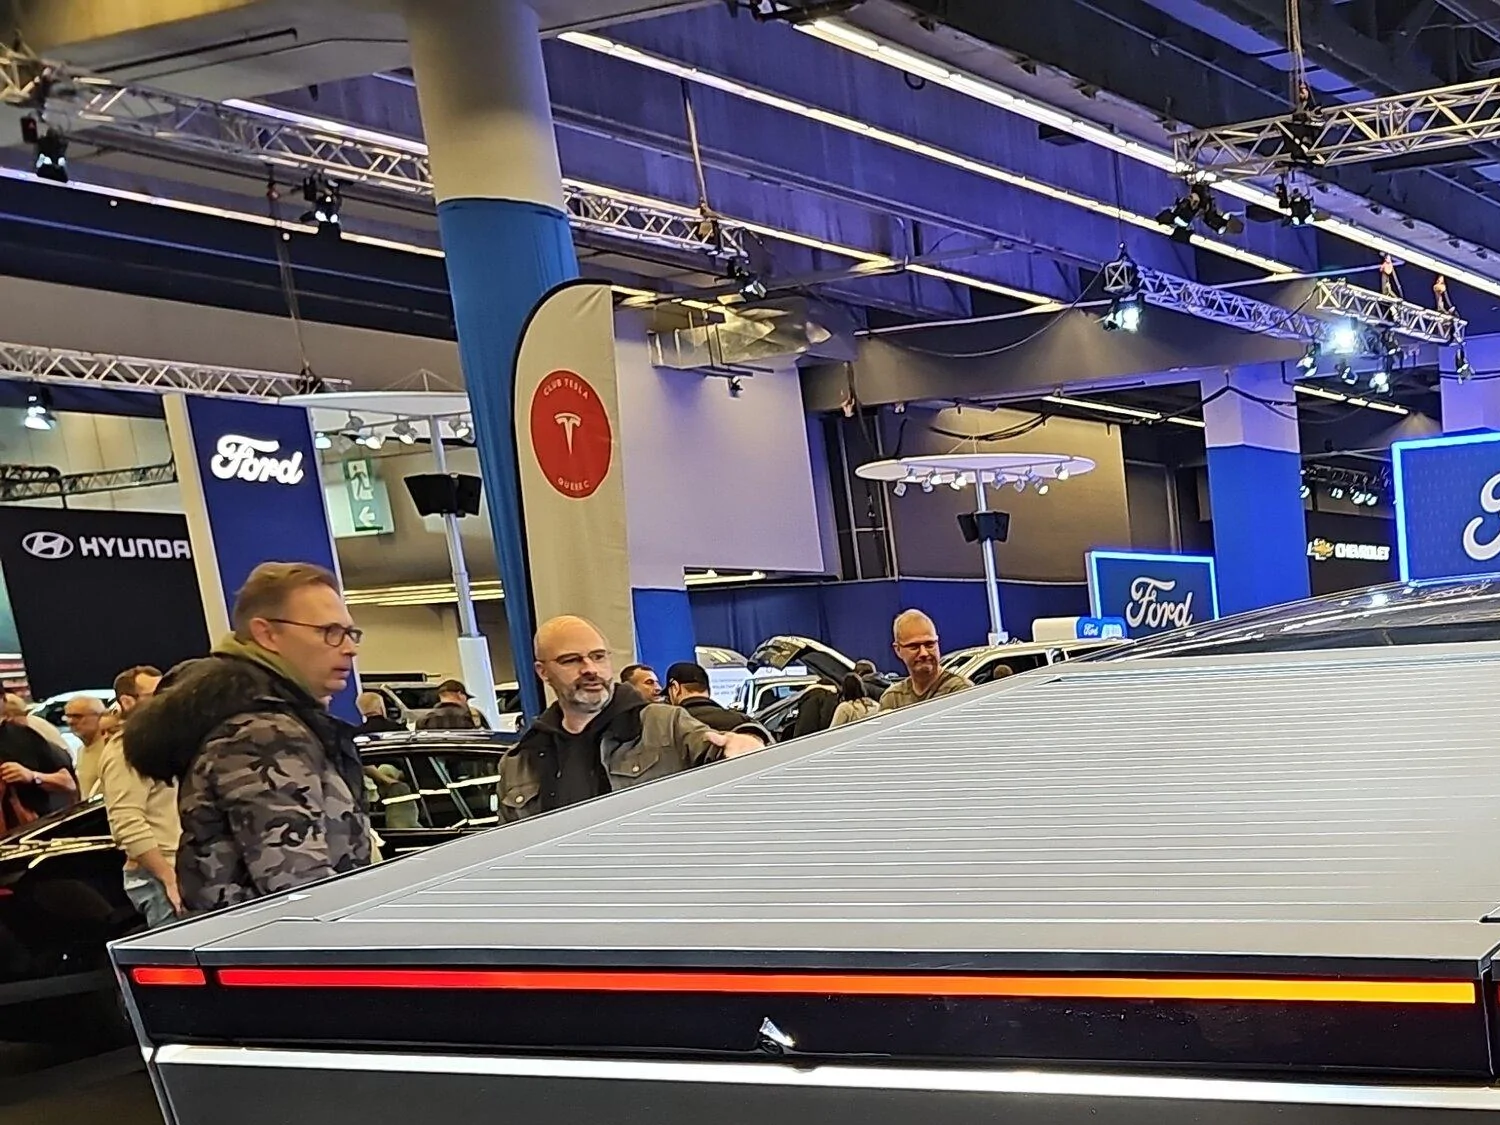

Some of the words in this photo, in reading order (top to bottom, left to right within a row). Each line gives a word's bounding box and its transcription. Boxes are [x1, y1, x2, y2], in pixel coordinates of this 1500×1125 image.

[543, 378, 562, 396] CLUB
[564, 378, 589, 399] TESLA
[211, 434, 304, 485] Ford
[79, 536, 191, 559] HYUNDA
[1126, 577, 1193, 628] Ford
